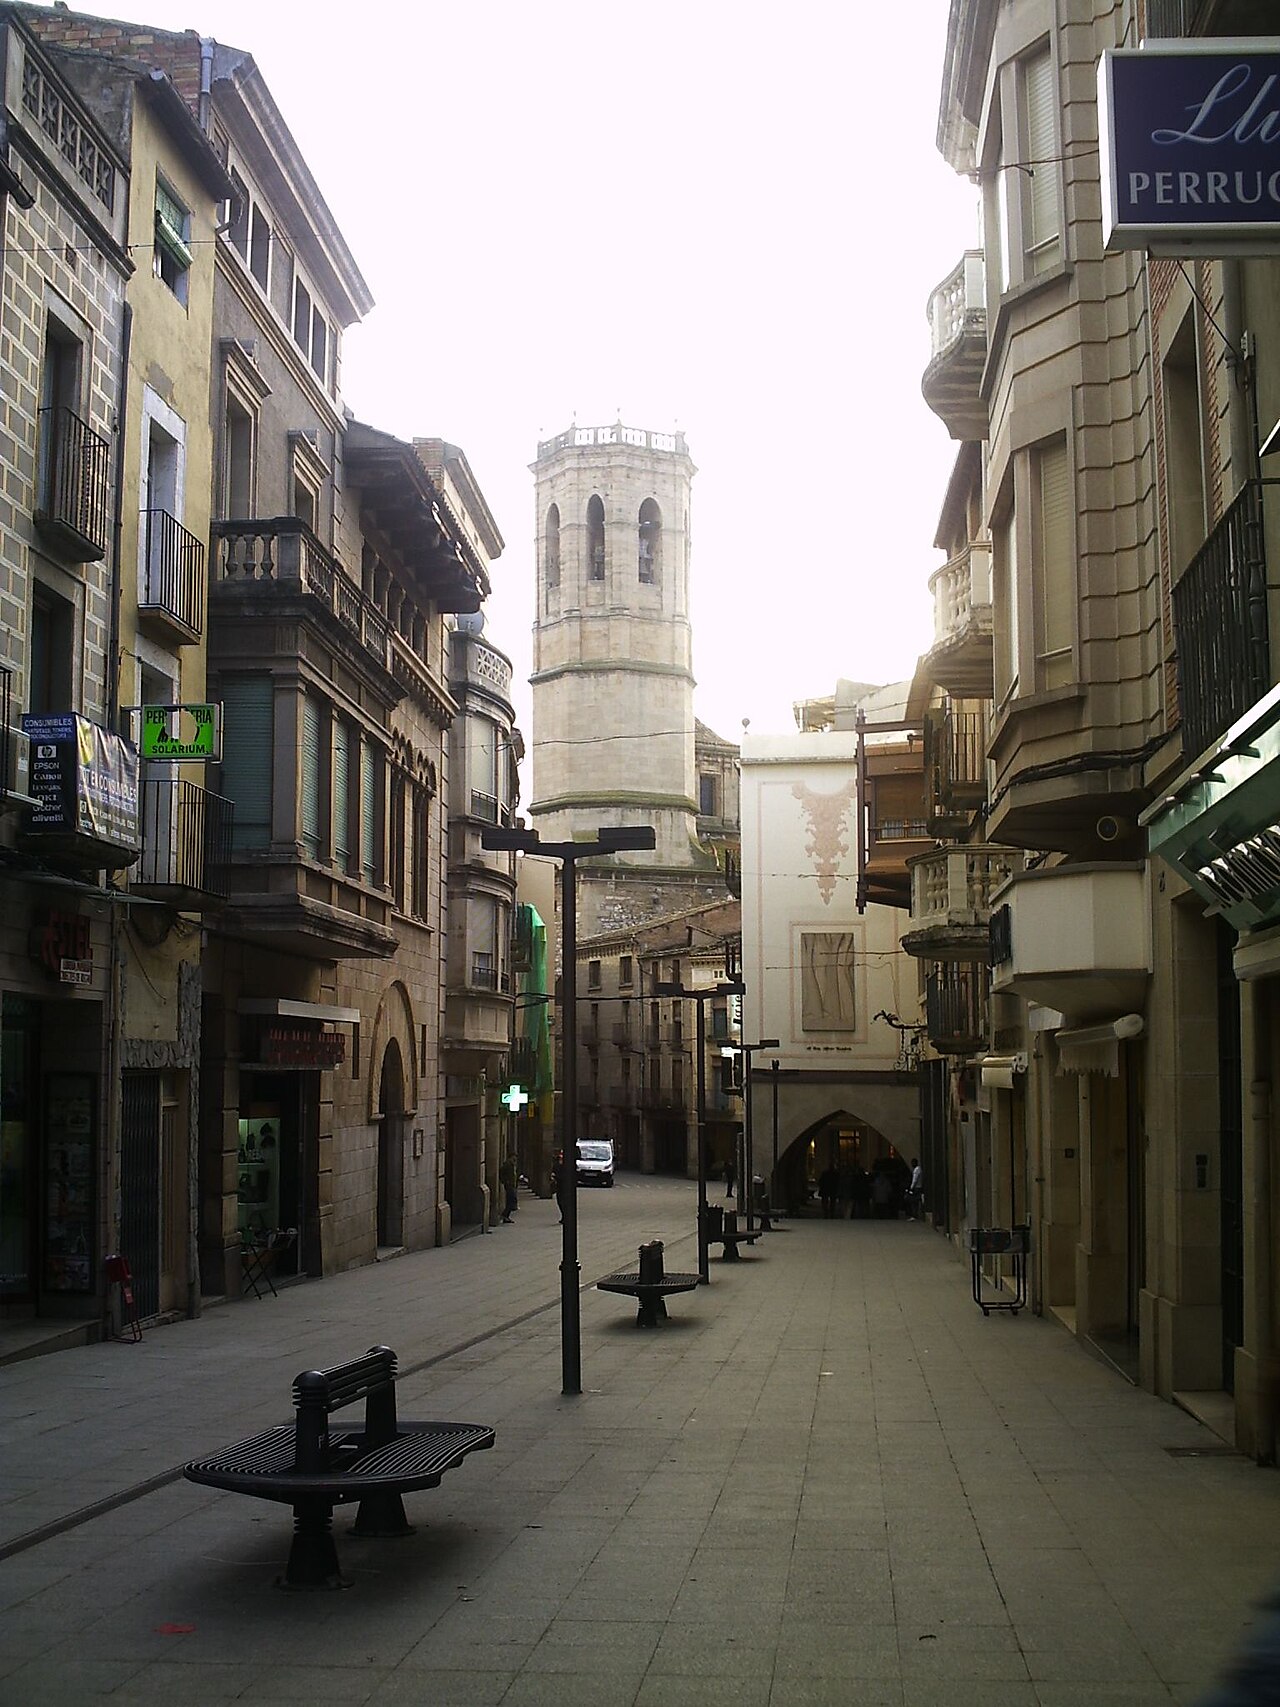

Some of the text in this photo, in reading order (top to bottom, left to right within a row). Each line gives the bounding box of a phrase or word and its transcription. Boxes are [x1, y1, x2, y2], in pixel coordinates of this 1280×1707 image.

[24, 718, 73, 727] CONSUMIBLES
[33, 762, 60, 770] EPSON
[32, 814, 64, 822] olivetti
